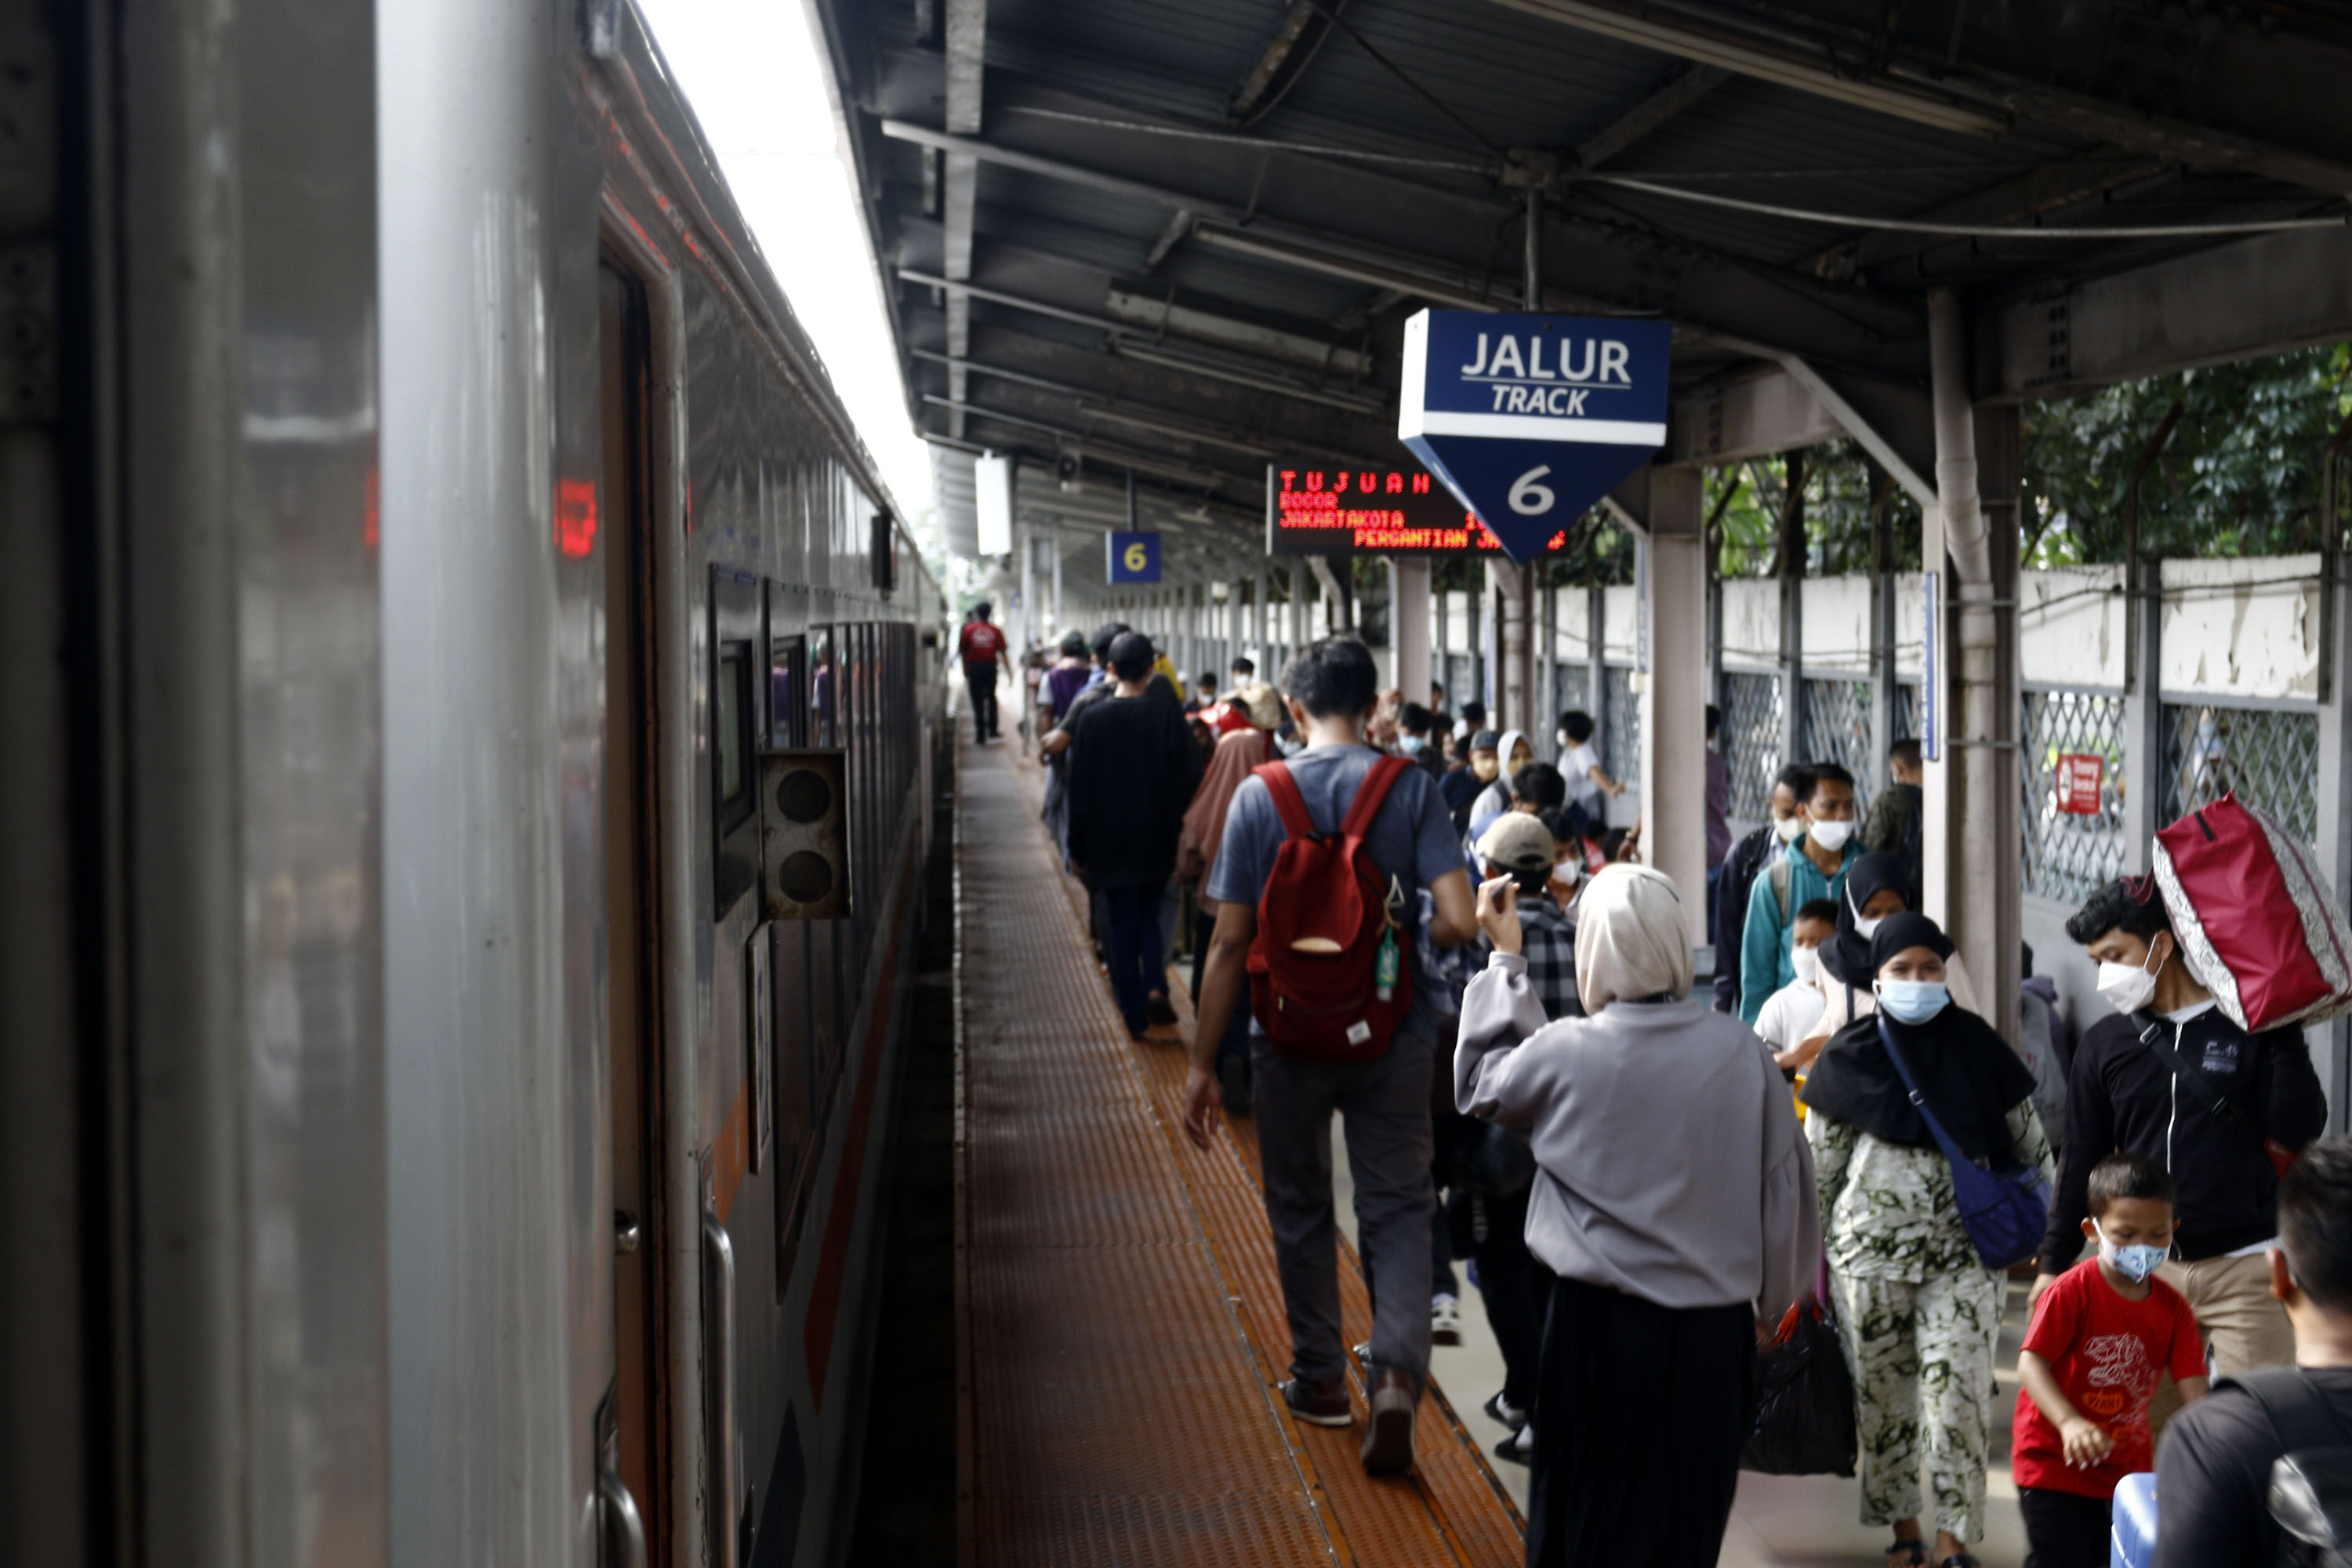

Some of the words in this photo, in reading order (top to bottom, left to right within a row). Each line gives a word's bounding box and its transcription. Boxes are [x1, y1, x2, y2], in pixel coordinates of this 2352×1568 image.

[1461, 332, 1632, 383] JALUR
[1491, 383, 1590, 416] TRACK
[1508, 464, 1555, 515] 6
[1354, 528, 1469, 548] PERGANTIAN
[1123, 542, 1147, 572] 6
